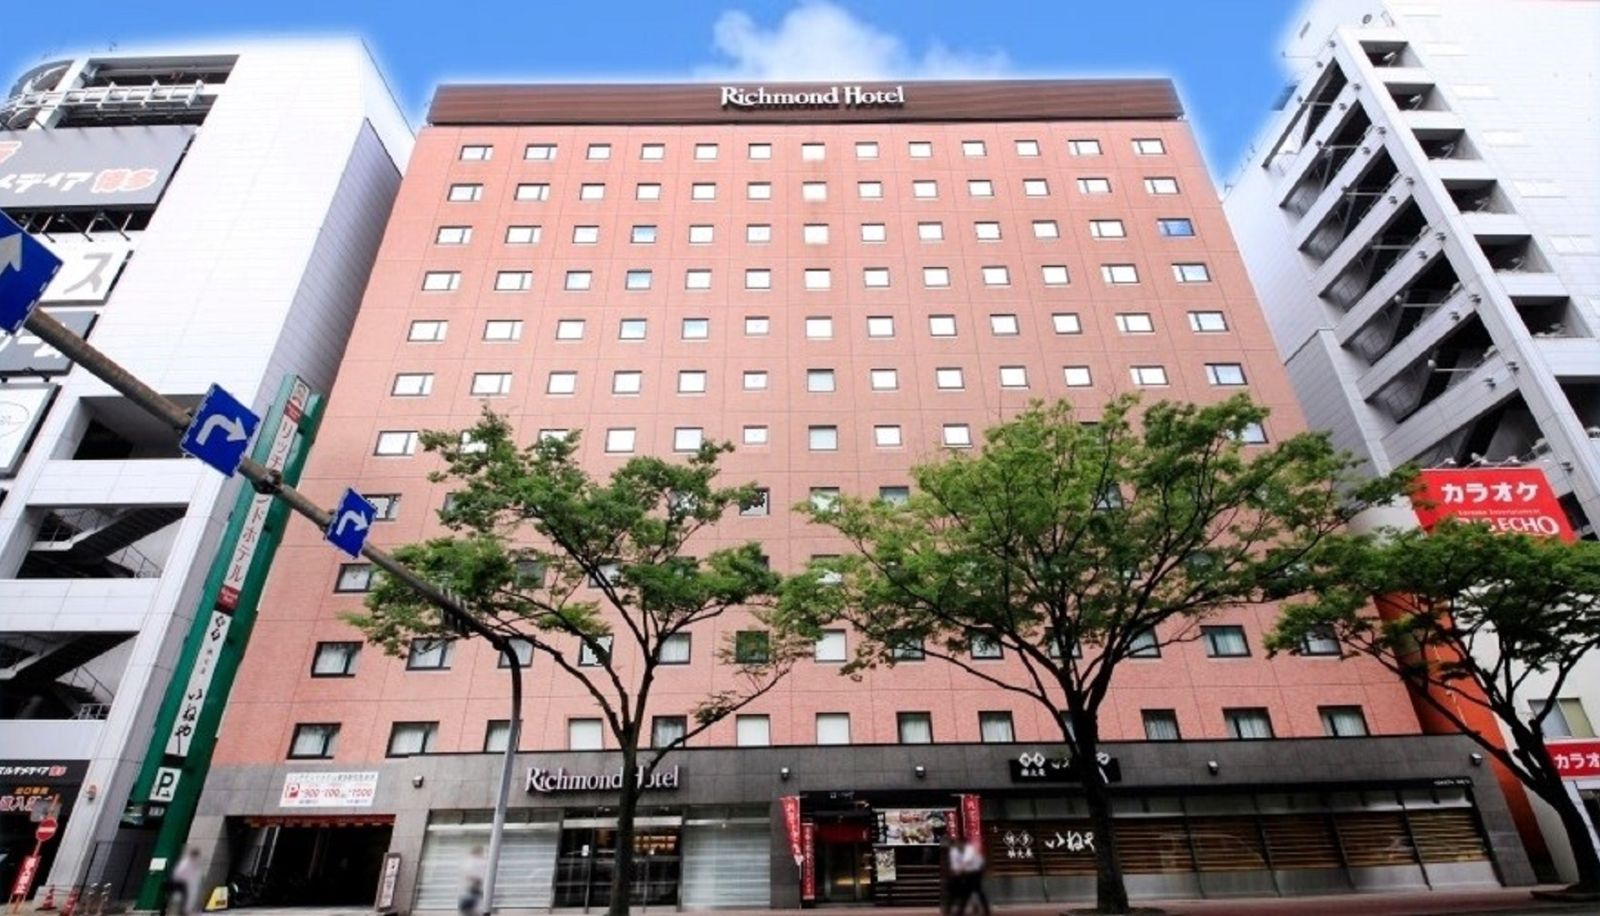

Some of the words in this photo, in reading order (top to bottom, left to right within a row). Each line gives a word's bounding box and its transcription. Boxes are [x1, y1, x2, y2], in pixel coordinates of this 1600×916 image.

[720, 86, 839, 107] Richmond
[843, 86, 905, 105] Hotel
[228, 425, 293, 582] リッチンドホテル
[1440, 481, 1539, 505] カラオケ
[154, 771, 175, 797] P
[524, 766, 624, 793] Richmond
[1044, 830, 1096, 854] いねや
